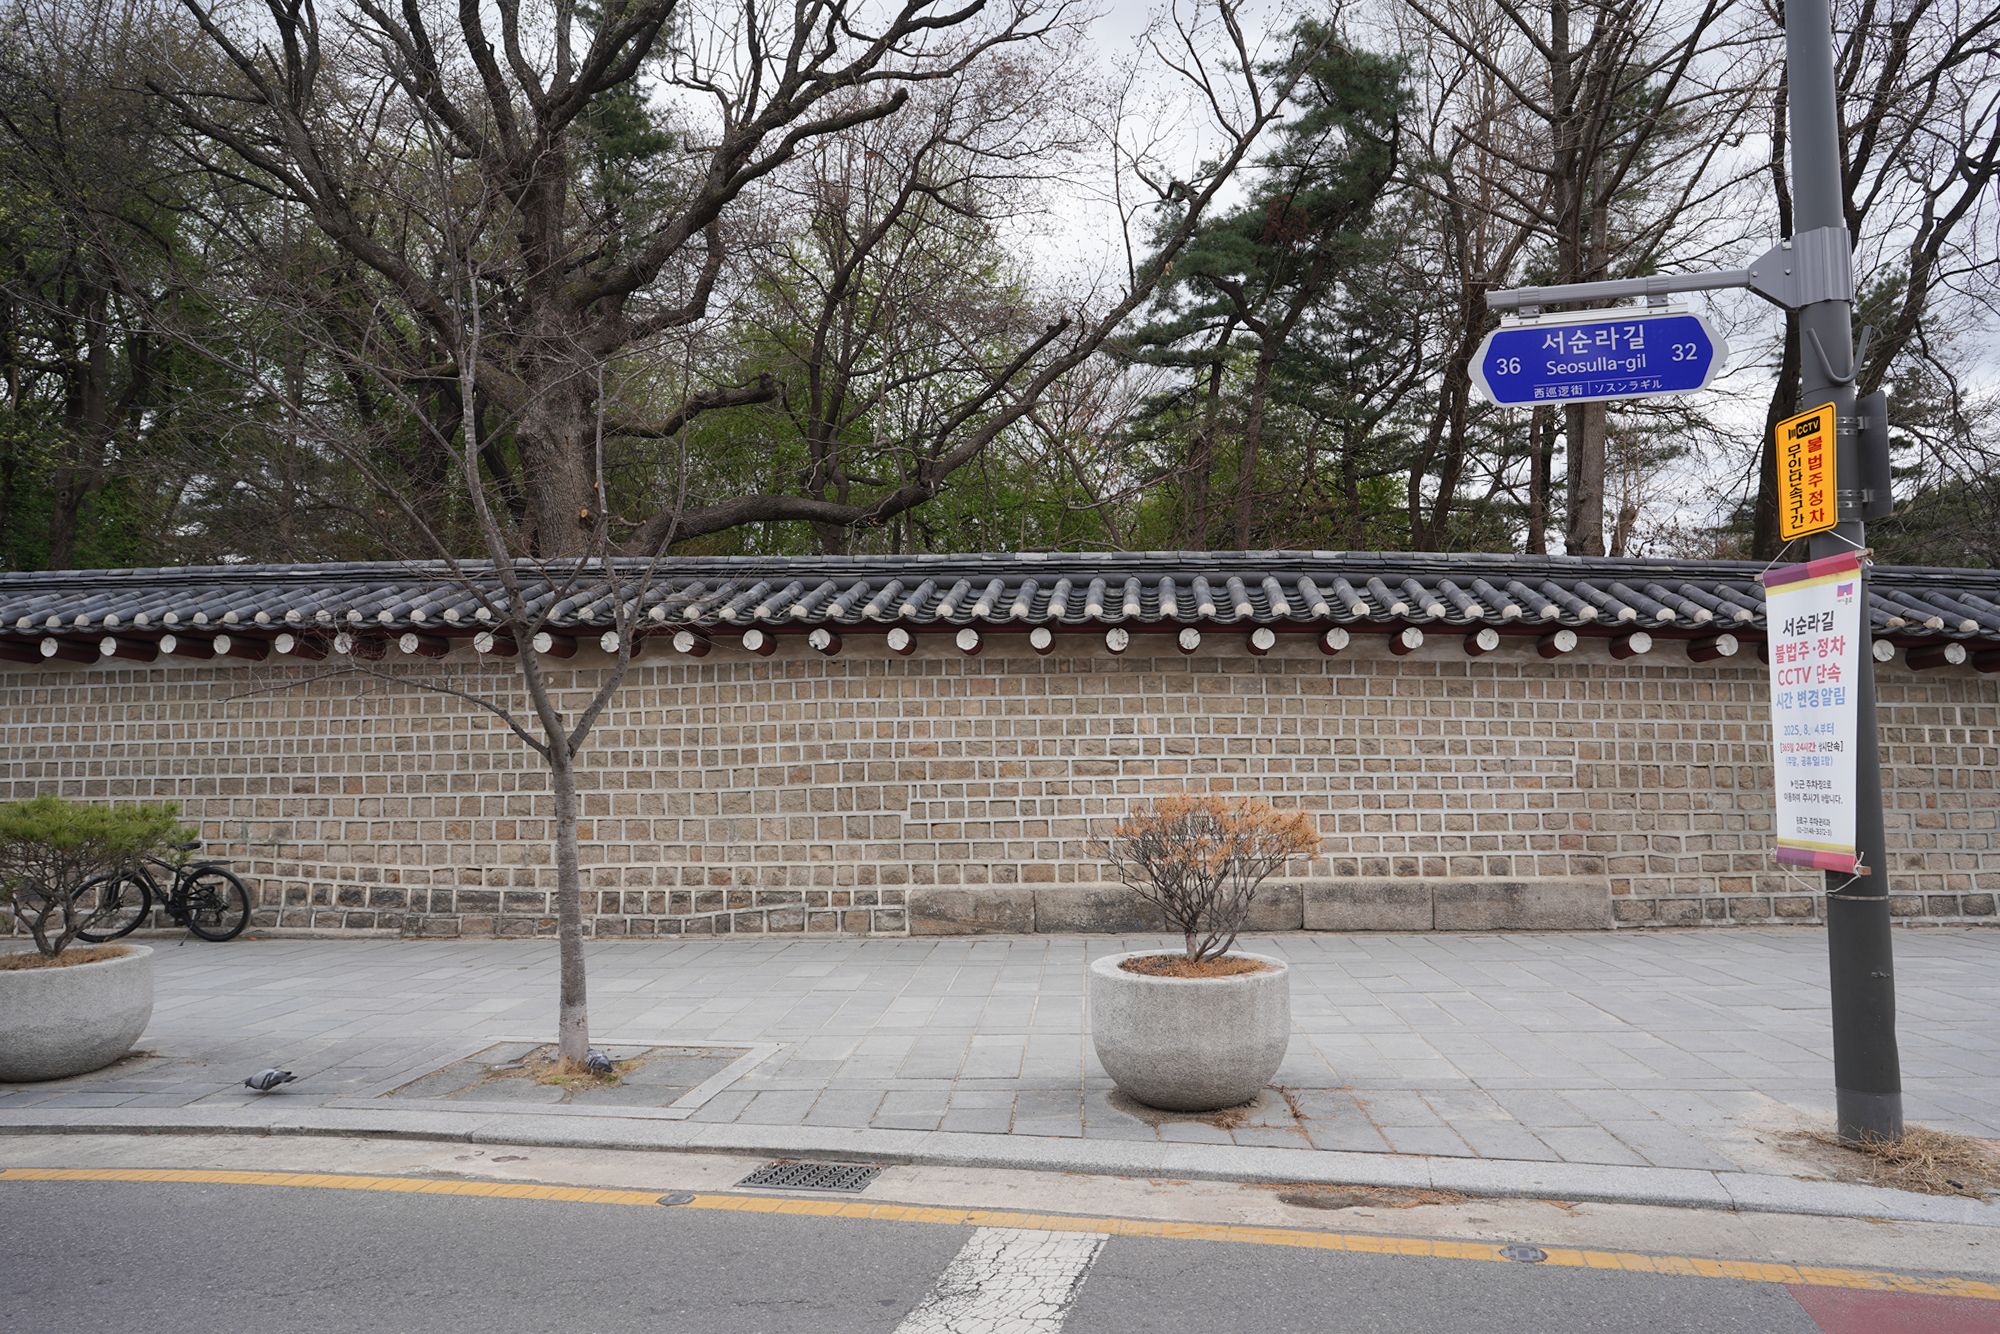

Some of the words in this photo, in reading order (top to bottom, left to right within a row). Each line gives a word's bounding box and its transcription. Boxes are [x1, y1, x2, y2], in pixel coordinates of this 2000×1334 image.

[1542, 324, 1645, 355] 서순라길
[1671, 343, 1698, 361] 32
[1496, 357, 1521, 375] 36
[1546, 354, 1646, 376] Seosulla-gil
[1594, 379, 1663, 393] ソスンラギル
[1797, 420, 1820, 435] CCTV
[1788, 443, 1804, 529] 무인단속구간
[1807, 435, 1824, 524] 불법주정차
[1782, 610, 1835, 636] 서순라길
[1775, 635, 1846, 665] 불법주·정차
[1777, 666, 1812, 686] CCTV
[1816, 662, 1841, 684] 단속
[1776, 691, 1793, 710] 시간
[1795, 741, 1816, 752] 24시간
[1802, 793, 1820, 804] 주시기
